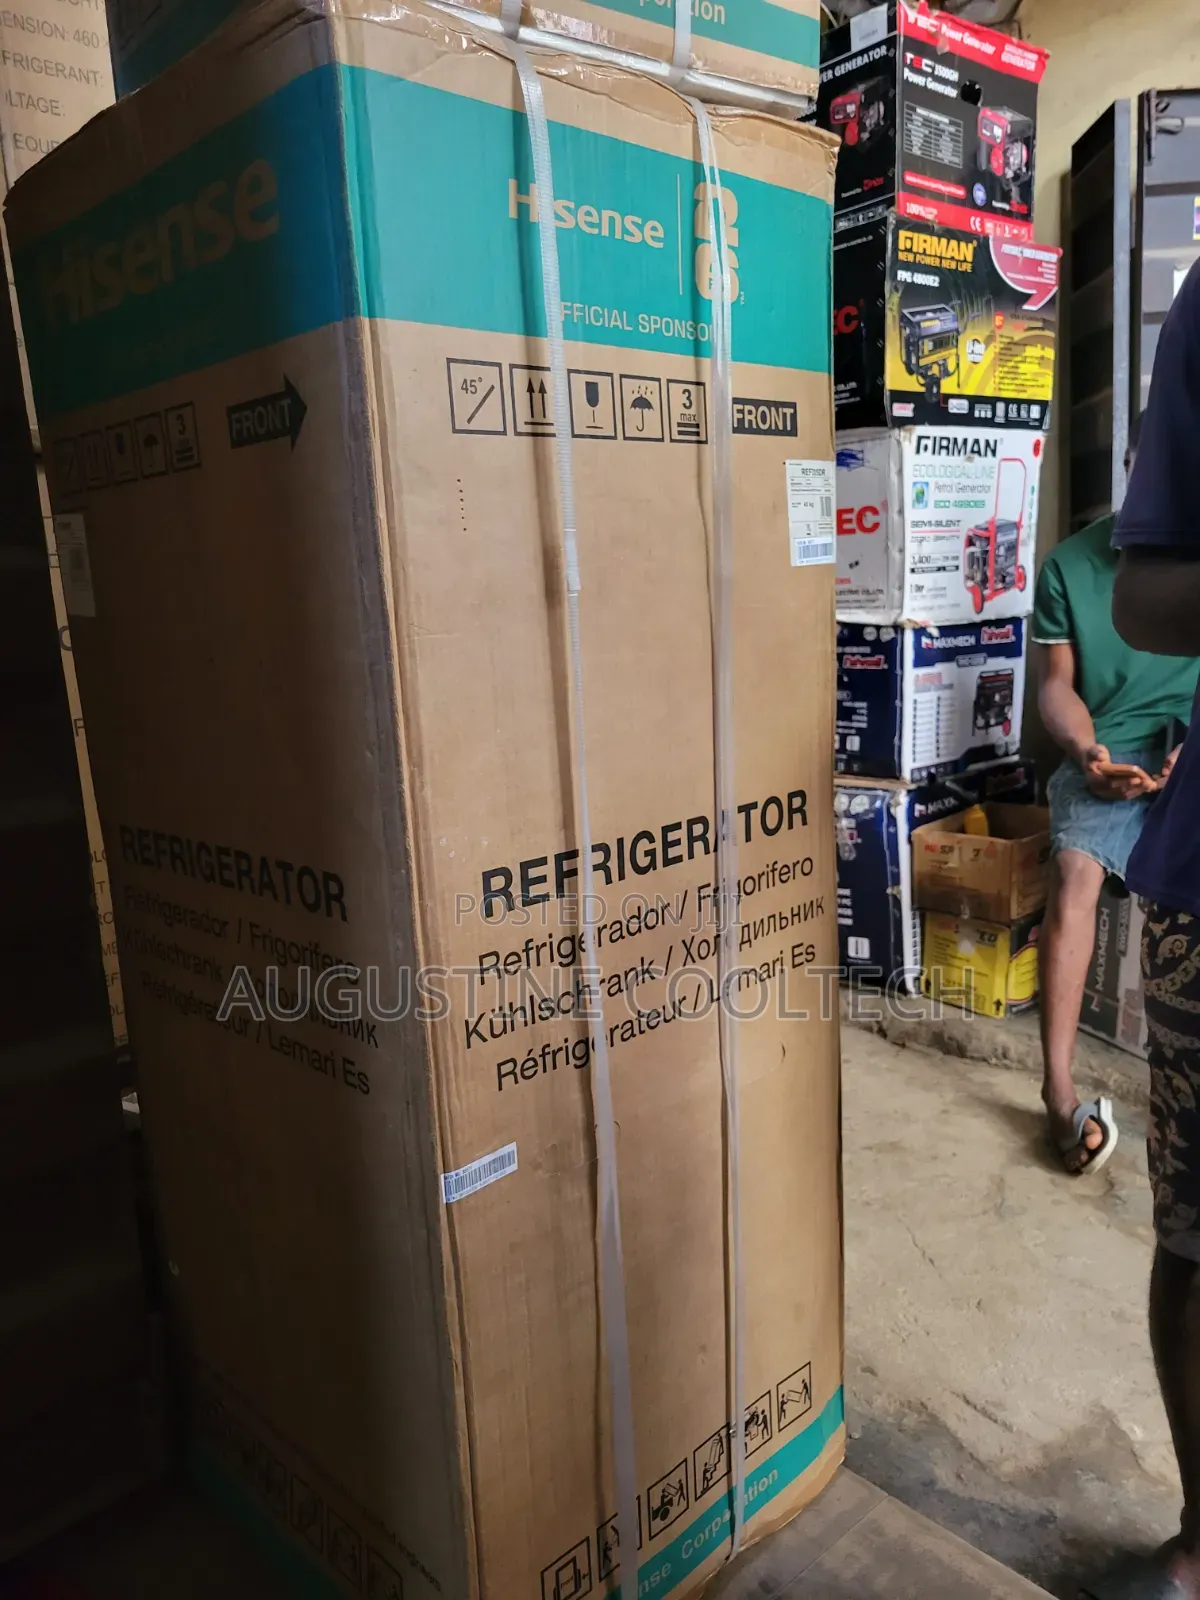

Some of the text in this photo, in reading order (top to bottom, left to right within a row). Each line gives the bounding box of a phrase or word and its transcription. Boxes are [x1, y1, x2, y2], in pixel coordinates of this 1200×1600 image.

[0, 10, 69, 42] ENSION:
[73, 29, 100, 49] 460
[1, 49, 104, 88] FRIGERANT:
[834, 44, 888, 77] GENERATOR
[904, 52, 930, 73] TEC
[904, 67, 958, 98] Power Generator
[508, 178, 665, 249] Hsense
[38, 157, 281, 333] Hisense
[898, 230, 974, 262] FIRMAN
[898, 251, 973, 273] NEW POWER NEW LIFE
[560, 302, 633, 331] FFICIAL
[682, 388, 693, 410] 3
[231, 398, 292, 440] FRONT
[680, 412, 697, 422] max
[732, 403, 795, 431] FRONT
[915, 435, 998, 458] FIRMAN
[934, 482, 992, 494] Petrol Generator
[836, 506, 880, 536] EC
[911, 519, 961, 528] SEMI-SILENT
[119, 825, 349, 922] REFRIGERATOR
[791, 942, 816, 969] Es
[465, 957, 656, 1050] Kühlschrank
[268, 1021, 337, 1079] Lemari
[343, 1056, 371, 1095] Es
